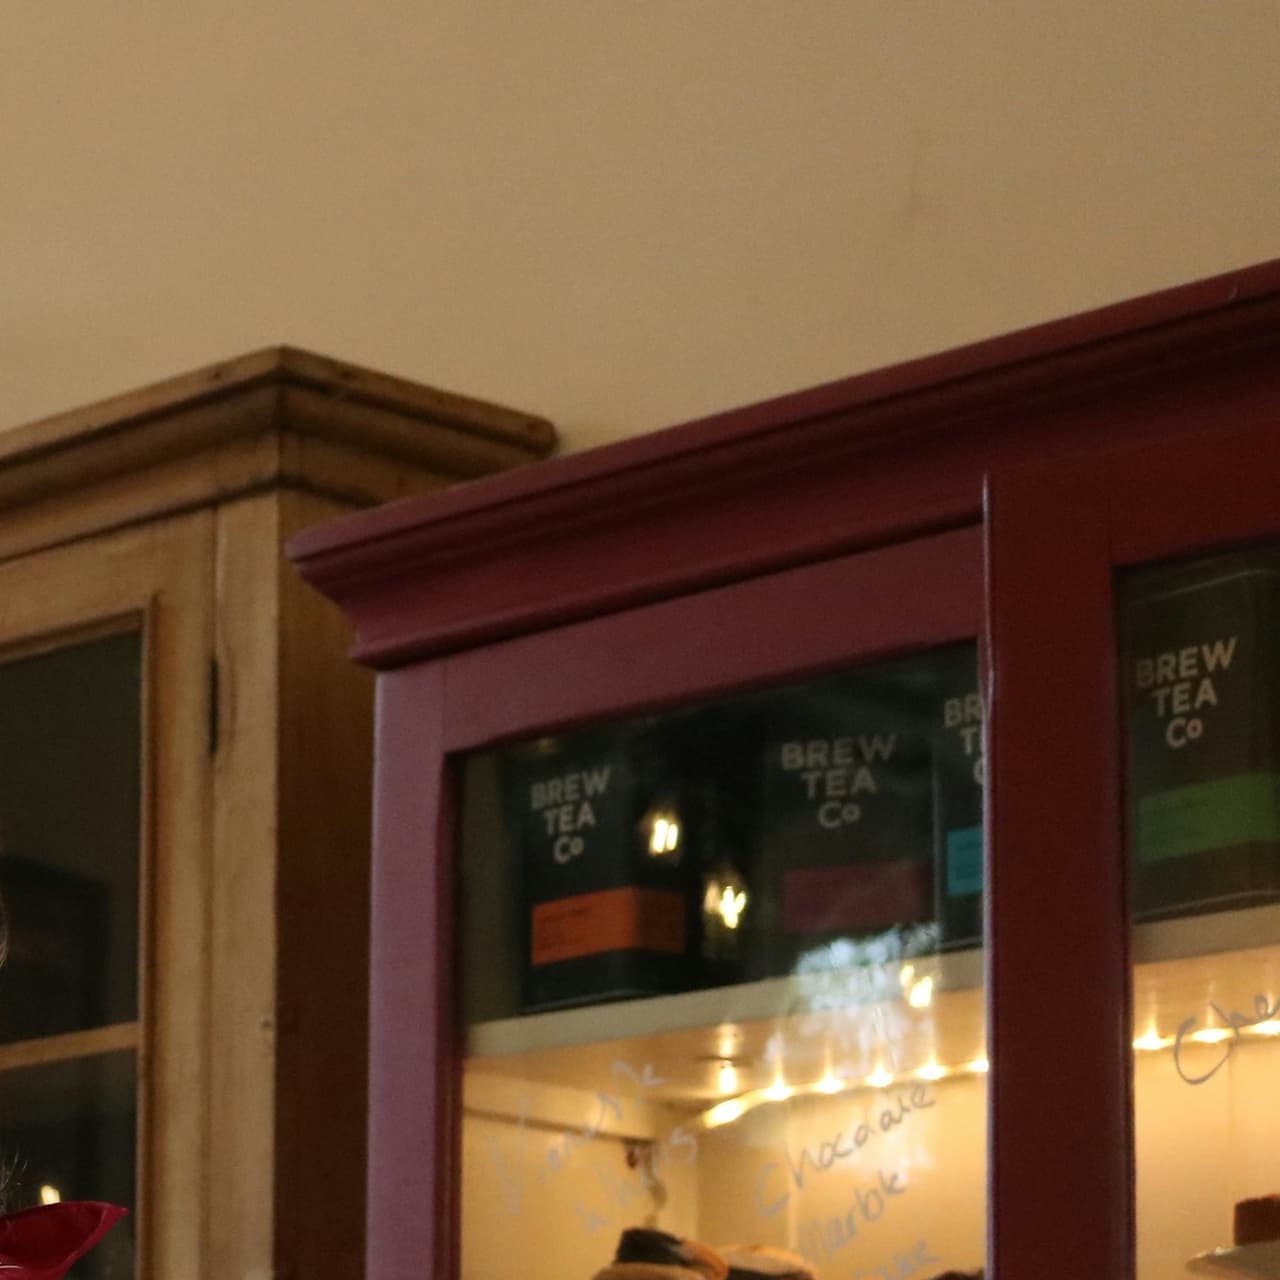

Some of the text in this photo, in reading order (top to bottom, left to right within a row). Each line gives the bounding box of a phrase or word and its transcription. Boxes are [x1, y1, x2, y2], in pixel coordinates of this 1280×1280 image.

[1136, 635, 1237, 689] BREW
[944, 692, 984, 729] BR
[1151, 676, 1218, 718] TEA
[1165, 717, 1203, 749] Co
[781, 734, 897, 771] BREW
[531, 767, 611, 810] BREW
[801, 767, 878, 799] TEA
[544, 801, 596, 837] TEA
[817, 801, 860, 829] Co
[553, 836, 584, 863] Co
